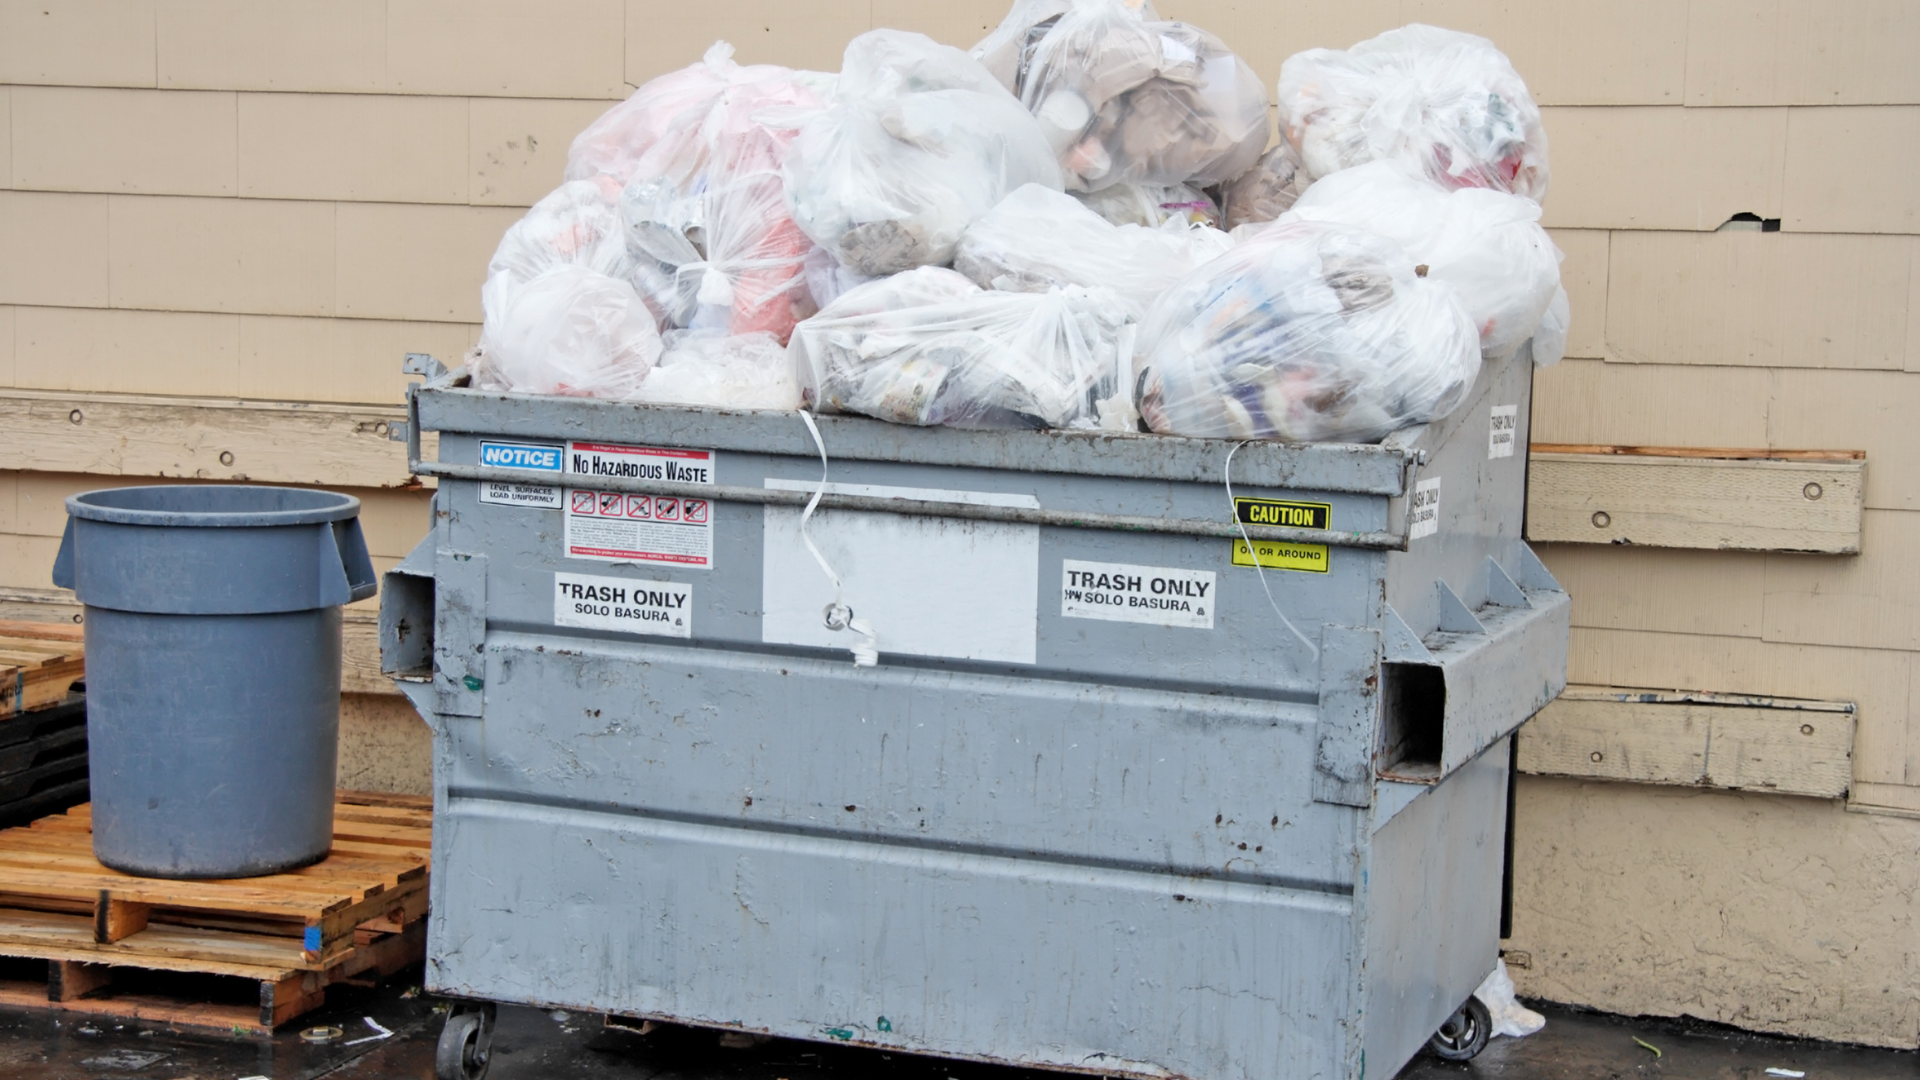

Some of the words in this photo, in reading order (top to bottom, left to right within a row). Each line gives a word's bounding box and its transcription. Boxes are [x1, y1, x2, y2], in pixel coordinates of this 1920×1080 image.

[1491, 415, 1503, 430] TRASH
[1503, 414, 1516, 430] ONLY
[485, 447, 556, 467] NOTICE
[490, 483, 511, 492] LEVEL
[490, 491, 509, 499] LOAD
[512, 493, 555, 503] UNIFORMLY
[1426, 487, 1440, 505] ONLY
[1249, 505, 1314, 526] CAUTION
[1259, 547, 1273, 556] OR
[1277, 549, 1321, 560] AROUND
[1067, 570, 1142, 592] TRASH
[1150, 577, 1210, 598] ONLY
[559, 582, 625, 604] TRASH
[633, 589, 687, 609] ONLY
[1084, 592, 1123, 606] SOLO
[1129, 596, 1191, 612] BASURA
[575, 602, 610, 616] SOLO
[614, 607, 670, 622] BASURA
